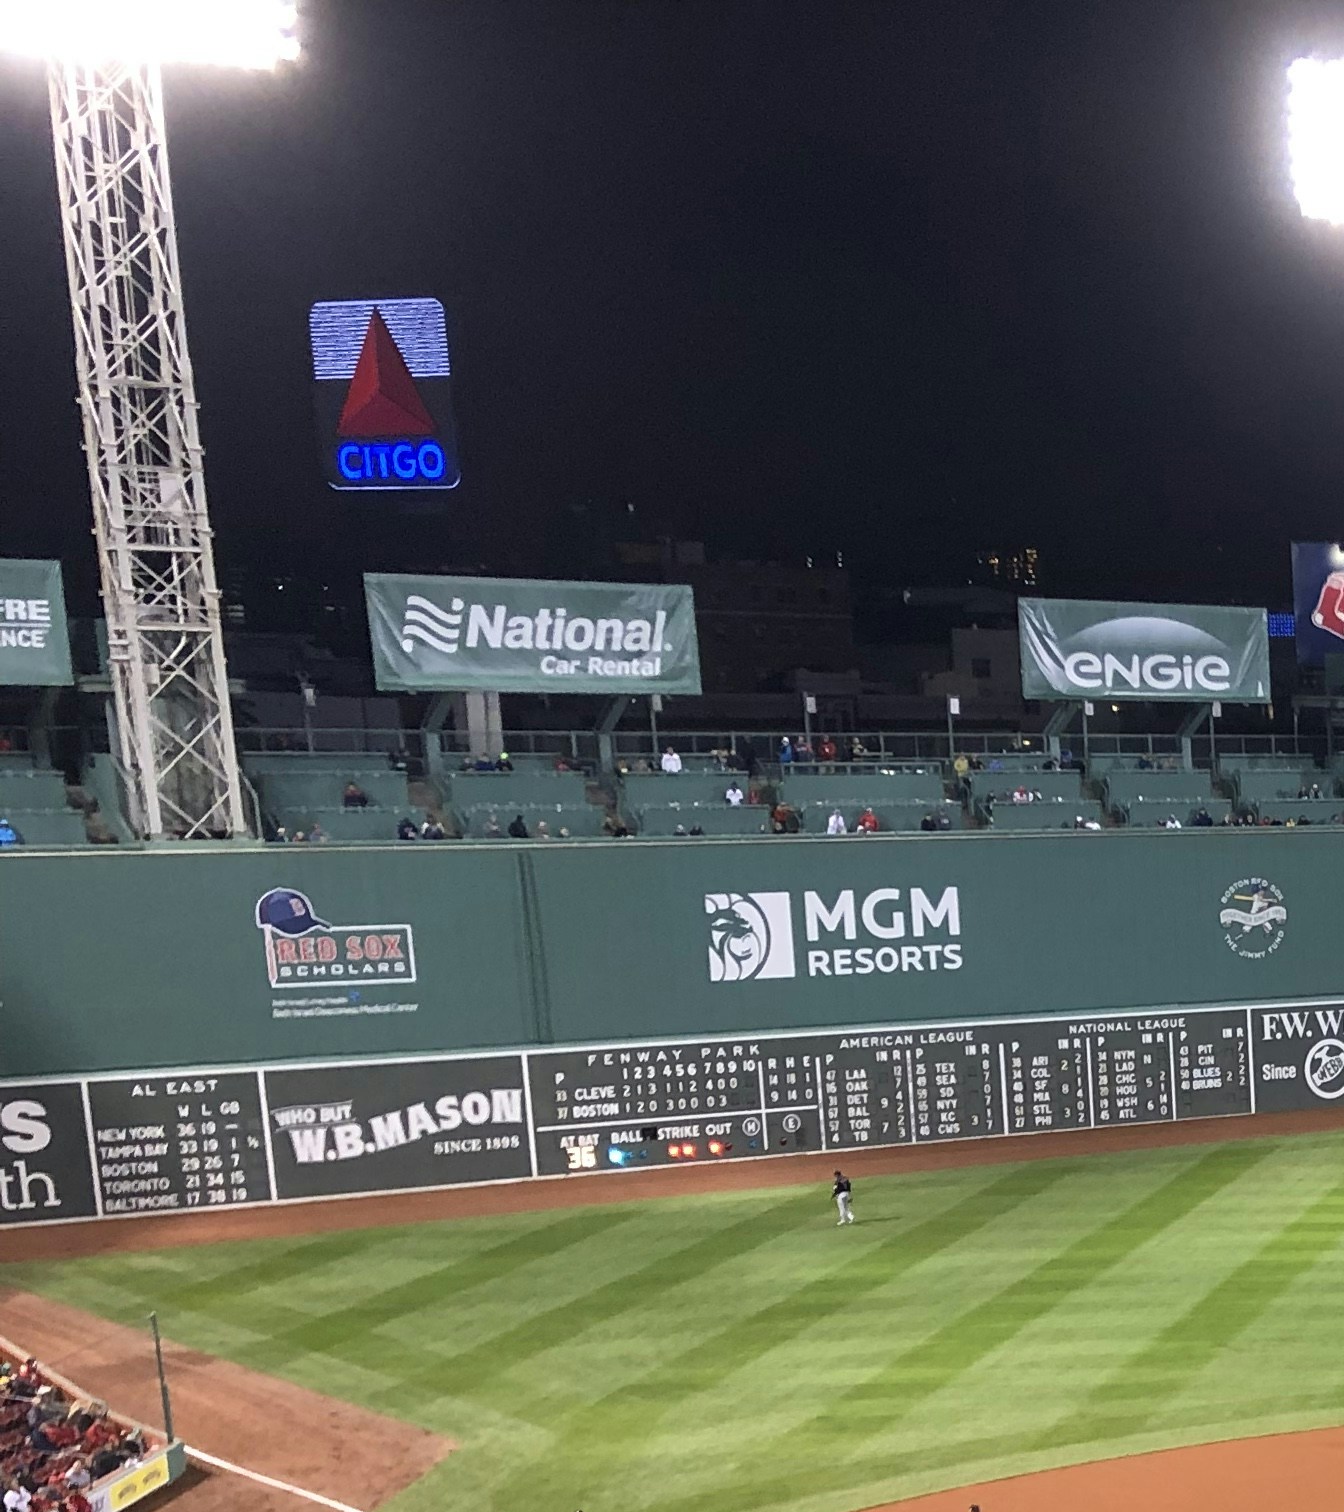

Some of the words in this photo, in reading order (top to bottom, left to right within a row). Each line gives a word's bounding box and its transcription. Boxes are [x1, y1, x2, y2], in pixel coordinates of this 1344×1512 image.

[337, 442, 447, 480] CITGO
[541, 655, 585, 676] Car
[589, 655, 661, 677] Rental
[804, 887, 960, 941] MGM
[276, 936, 337, 963] RED
[346, 935, 404, 961] SOX
[1224, 933, 1238, 951] THE
[1239, 950, 1265, 959] JIMMY
[1267, 930, 1284, 953] FUND
[280, 961, 405, 976] SCHOLARS
[808, 944, 962, 977] RESORTS
[1069, 1023, 1131, 1034] NATIONAL
[1137, 1018, 1186, 1030] LEAGUE
[1261, 1012, 1313, 1041] F.W.
[839, 1035, 913, 1049] AMERICAN
[920, 1031, 974, 1044] LEAGUE
[588, 1050, 682, 1066] FENWAY
[701, 1045, 760, 1058] PARK
[1262, 1064, 1297, 1080] Since
[132, 1083, 156, 1097] AL
[166, 1079, 218, 1095] EAST
[574, 1085, 615, 1101] CLEVE
[274, 1109, 315, 1127] WHO
[320, 1104, 352, 1122] BUT
[573, 1102, 619, 1118] BOSTON
[0, 1100, 51, 1153] S
[611, 1130, 643, 1144] BALL
[657, 1124, 700, 1140] STRIKE
[705, 1122, 732, 1136] OUT
[434, 1137, 482, 1155] SINCE
[0, 1160, 61, 1211] th
